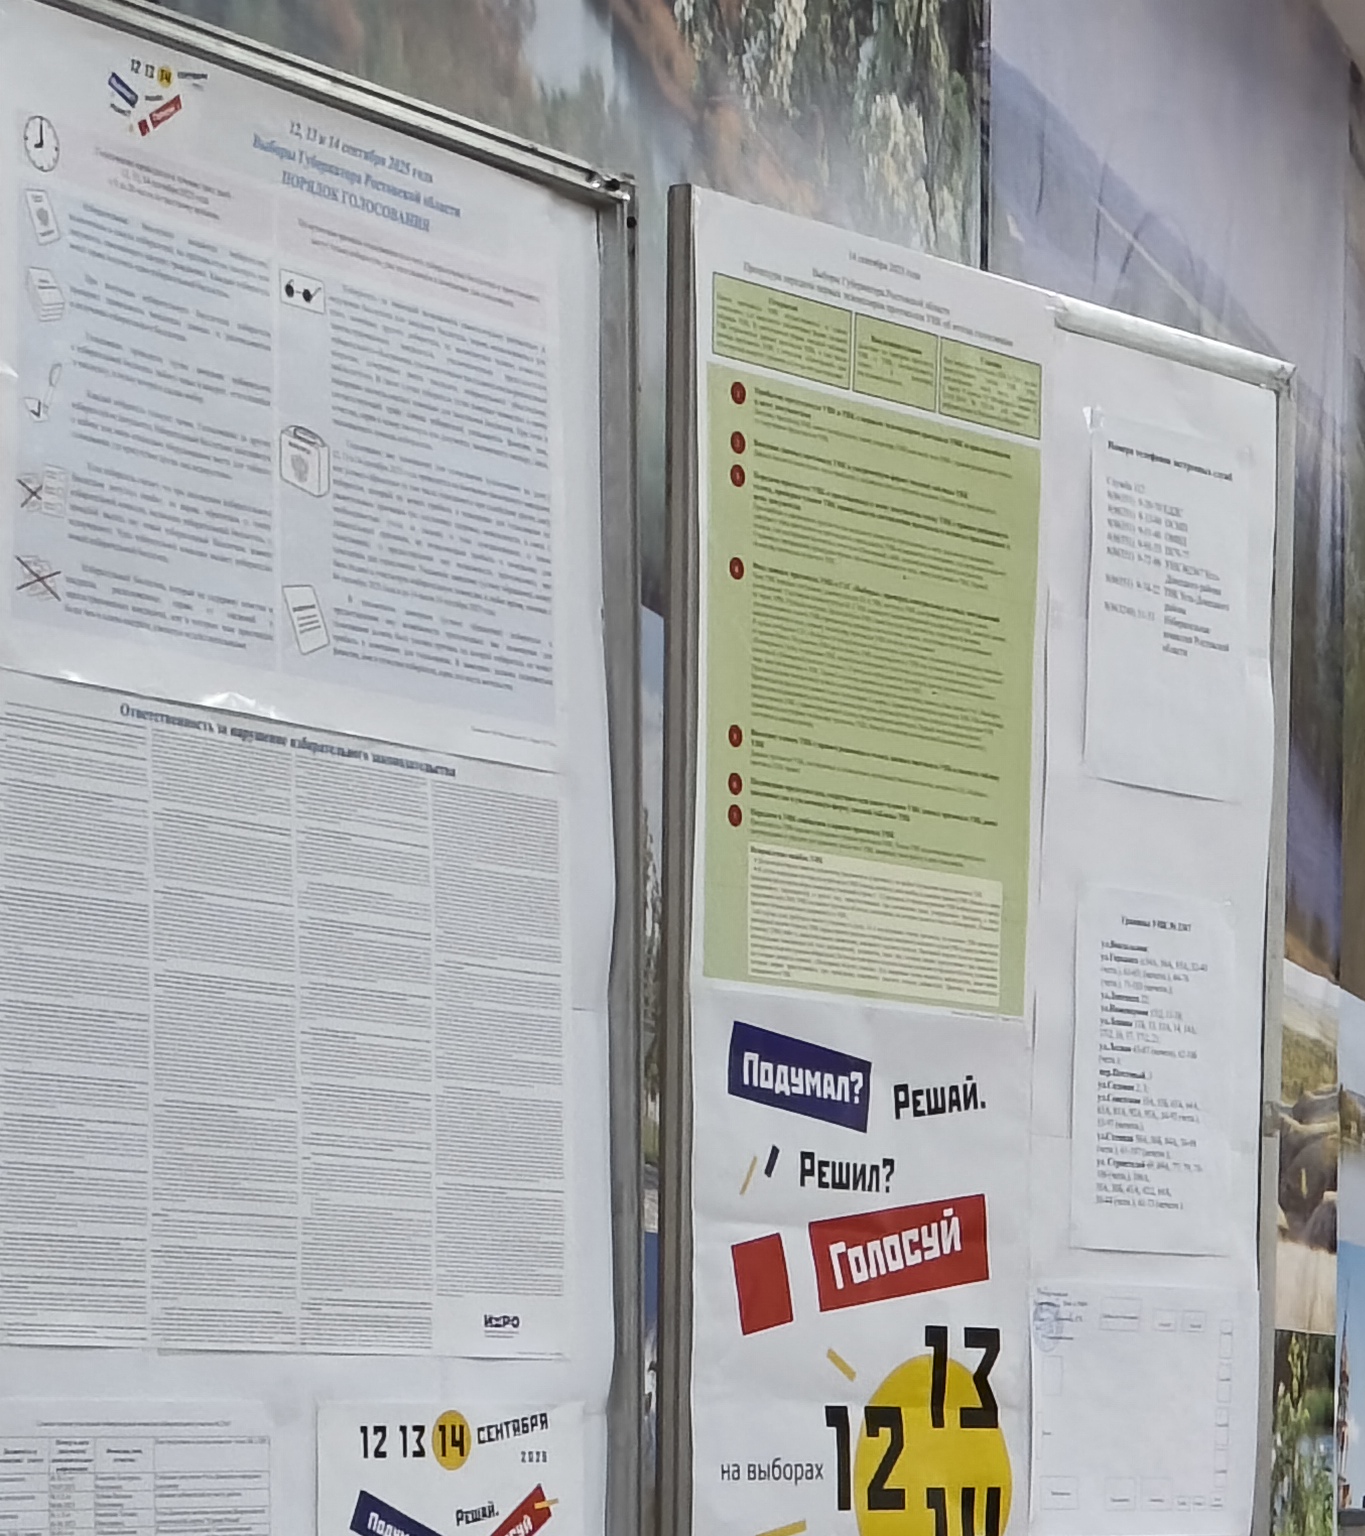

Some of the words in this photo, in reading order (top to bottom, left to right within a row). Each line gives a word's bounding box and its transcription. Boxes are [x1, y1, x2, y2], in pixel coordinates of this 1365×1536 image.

[924, 1325, 1001, 1429] 13
[360, 1425, 388, 1459] 12
[398, 1425, 426, 1458] 13
[438, 1424, 465, 1457] 14
[476, 1412, 549, 1445] СЕНТЯБРЯ
[720, 1462, 741, 1482] на
[747, 1457, 824, 1486] выборах
[824, 1405, 906, 1511] 12
